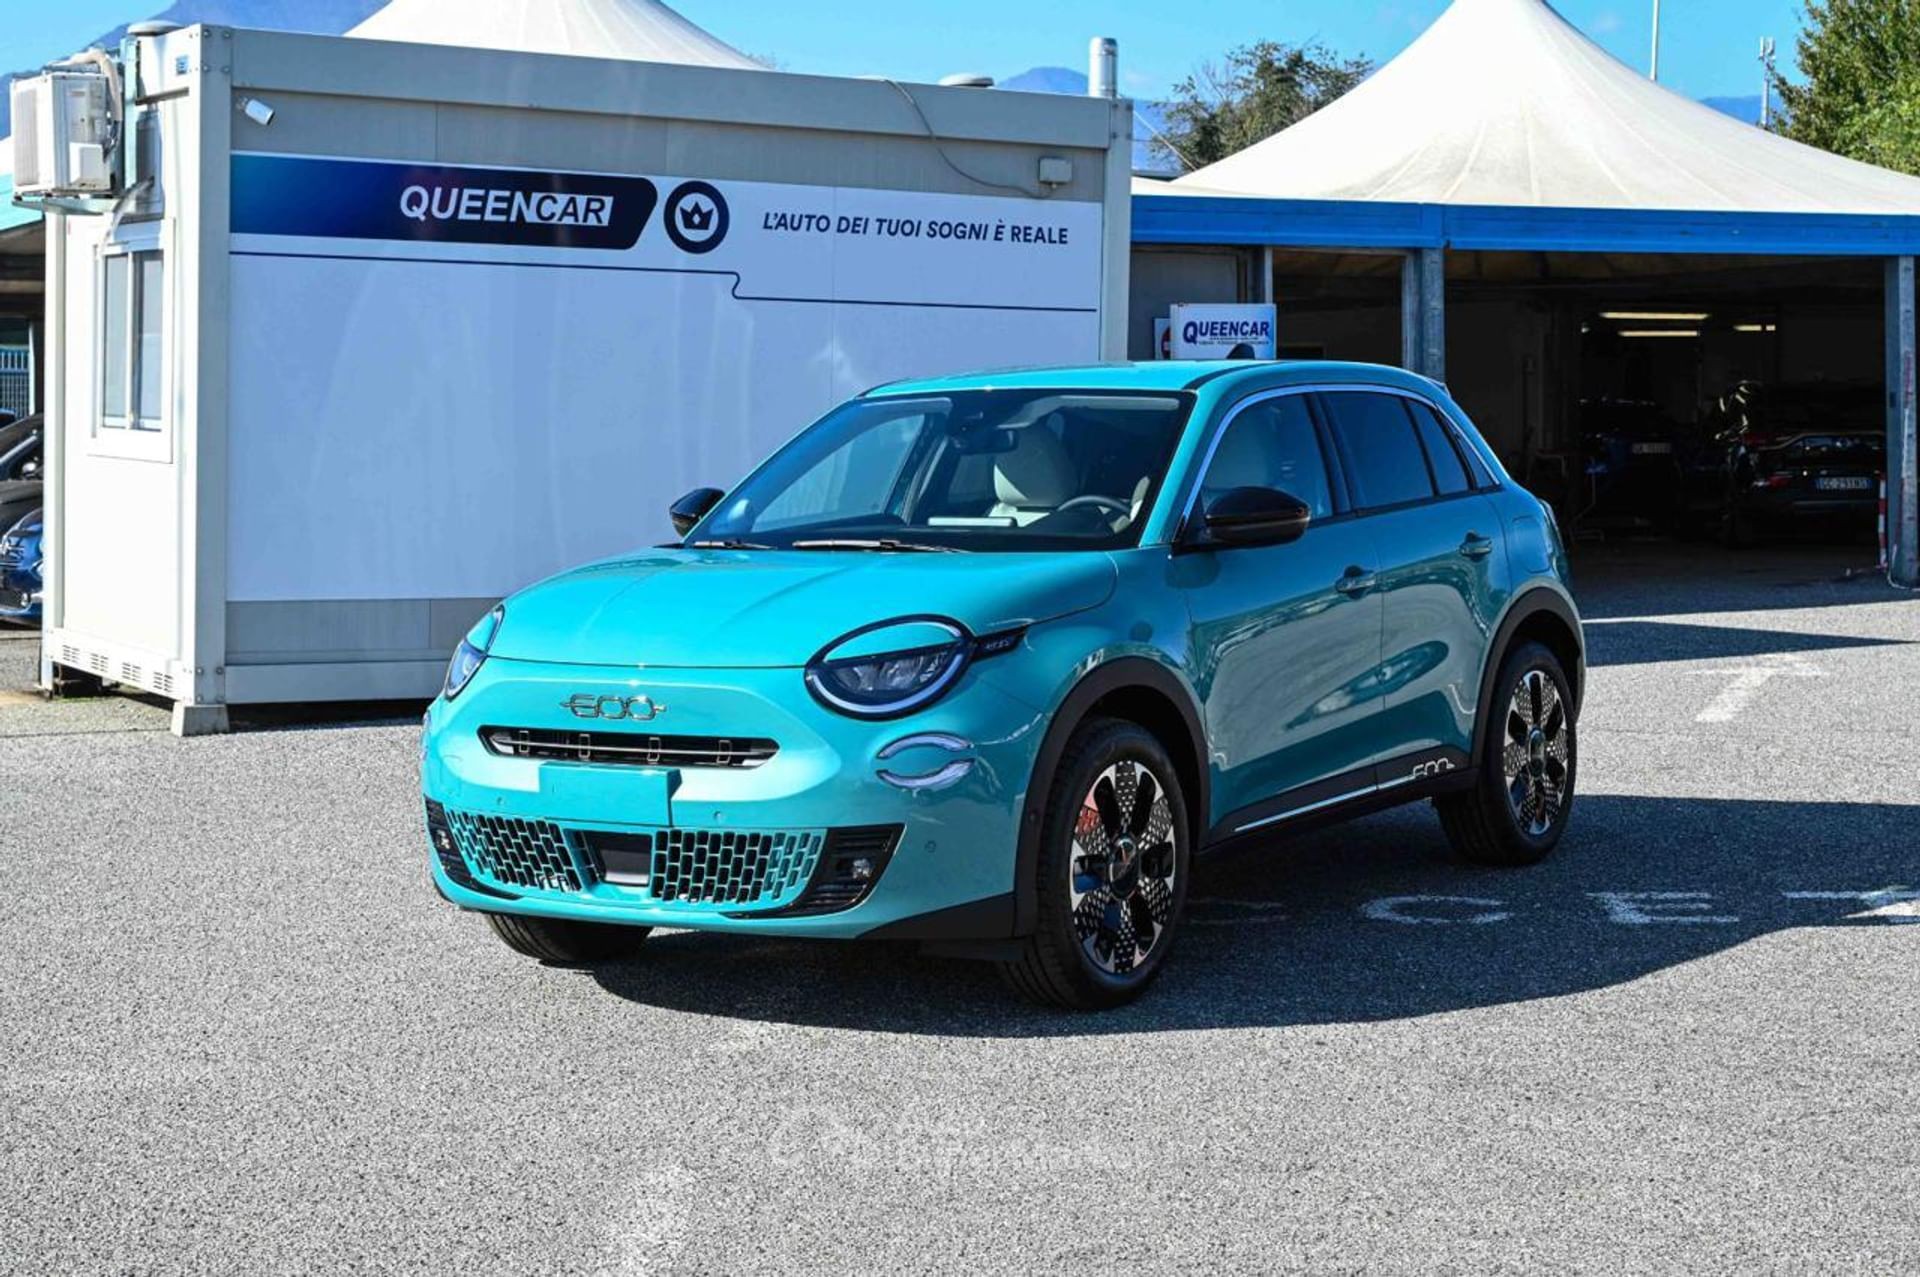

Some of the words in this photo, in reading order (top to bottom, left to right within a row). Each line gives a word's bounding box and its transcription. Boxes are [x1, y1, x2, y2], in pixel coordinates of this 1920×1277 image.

[400, 185, 613, 226] QUEENCAR
[836, 215, 868, 235] DEI
[876, 218, 921, 238] TUOI
[926, 220, 988, 240] SOGNI
[993, 219, 1005, 242] È
[1010, 225, 1068, 244] REALE
[1183, 321, 1269, 344] QUEENCAR
[563, 693, 664, 721] 600
